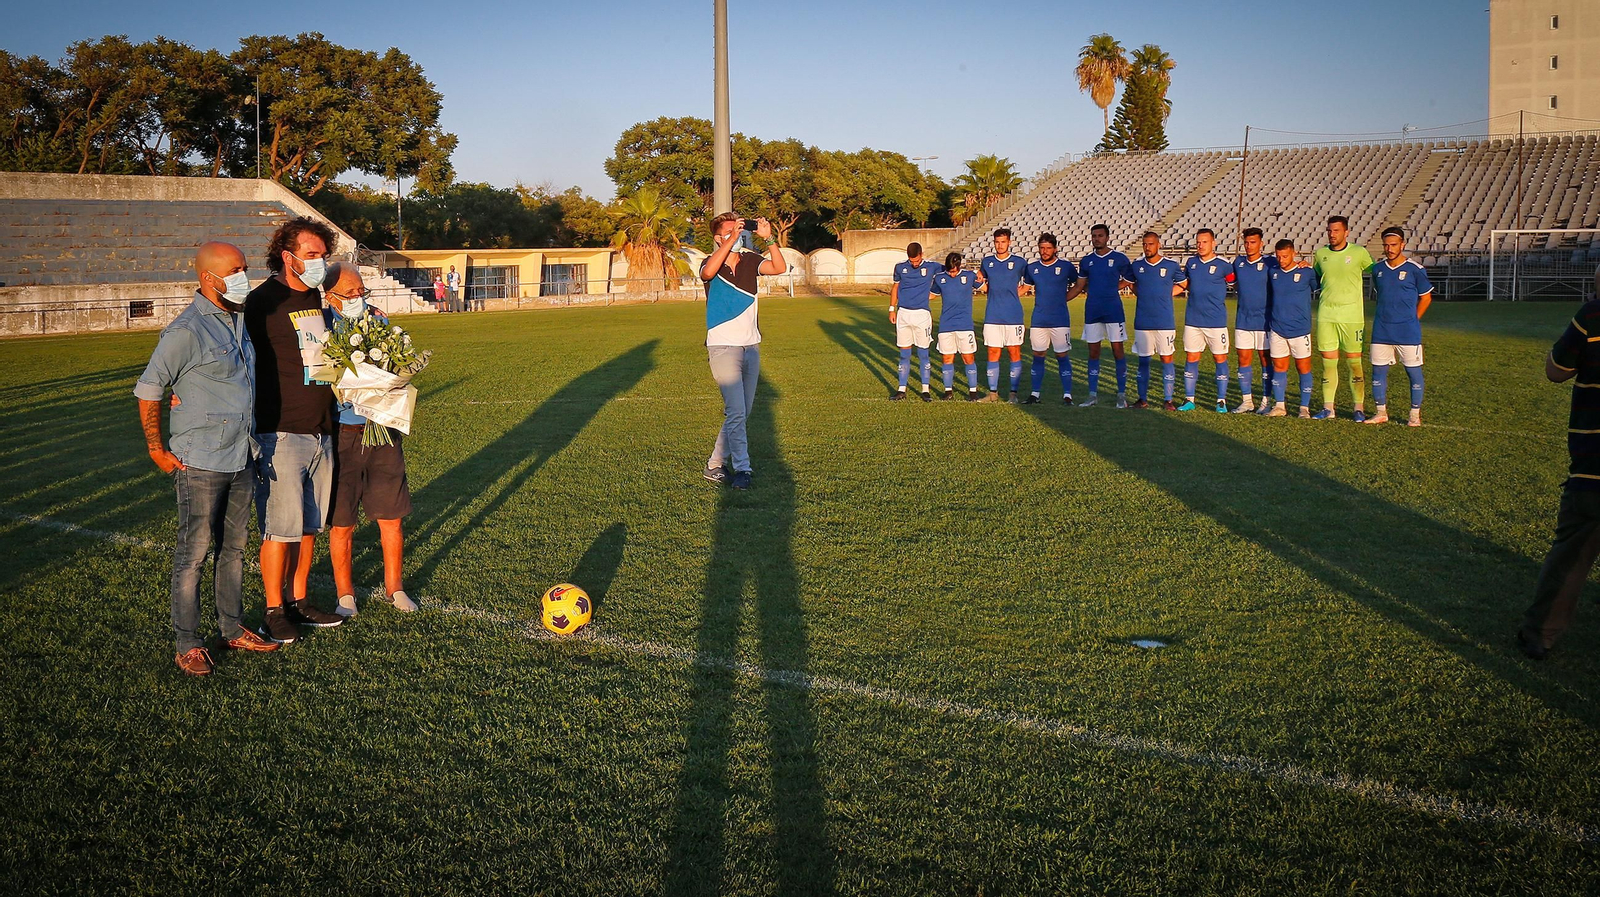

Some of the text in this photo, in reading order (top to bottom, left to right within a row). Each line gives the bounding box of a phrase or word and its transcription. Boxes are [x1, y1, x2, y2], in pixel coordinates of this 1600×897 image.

[1015, 325, 1022, 336] 18
[968, 333, 974, 344] 2
[1220, 333, 1226, 344] 8
[1303, 335, 1309, 347] 3
